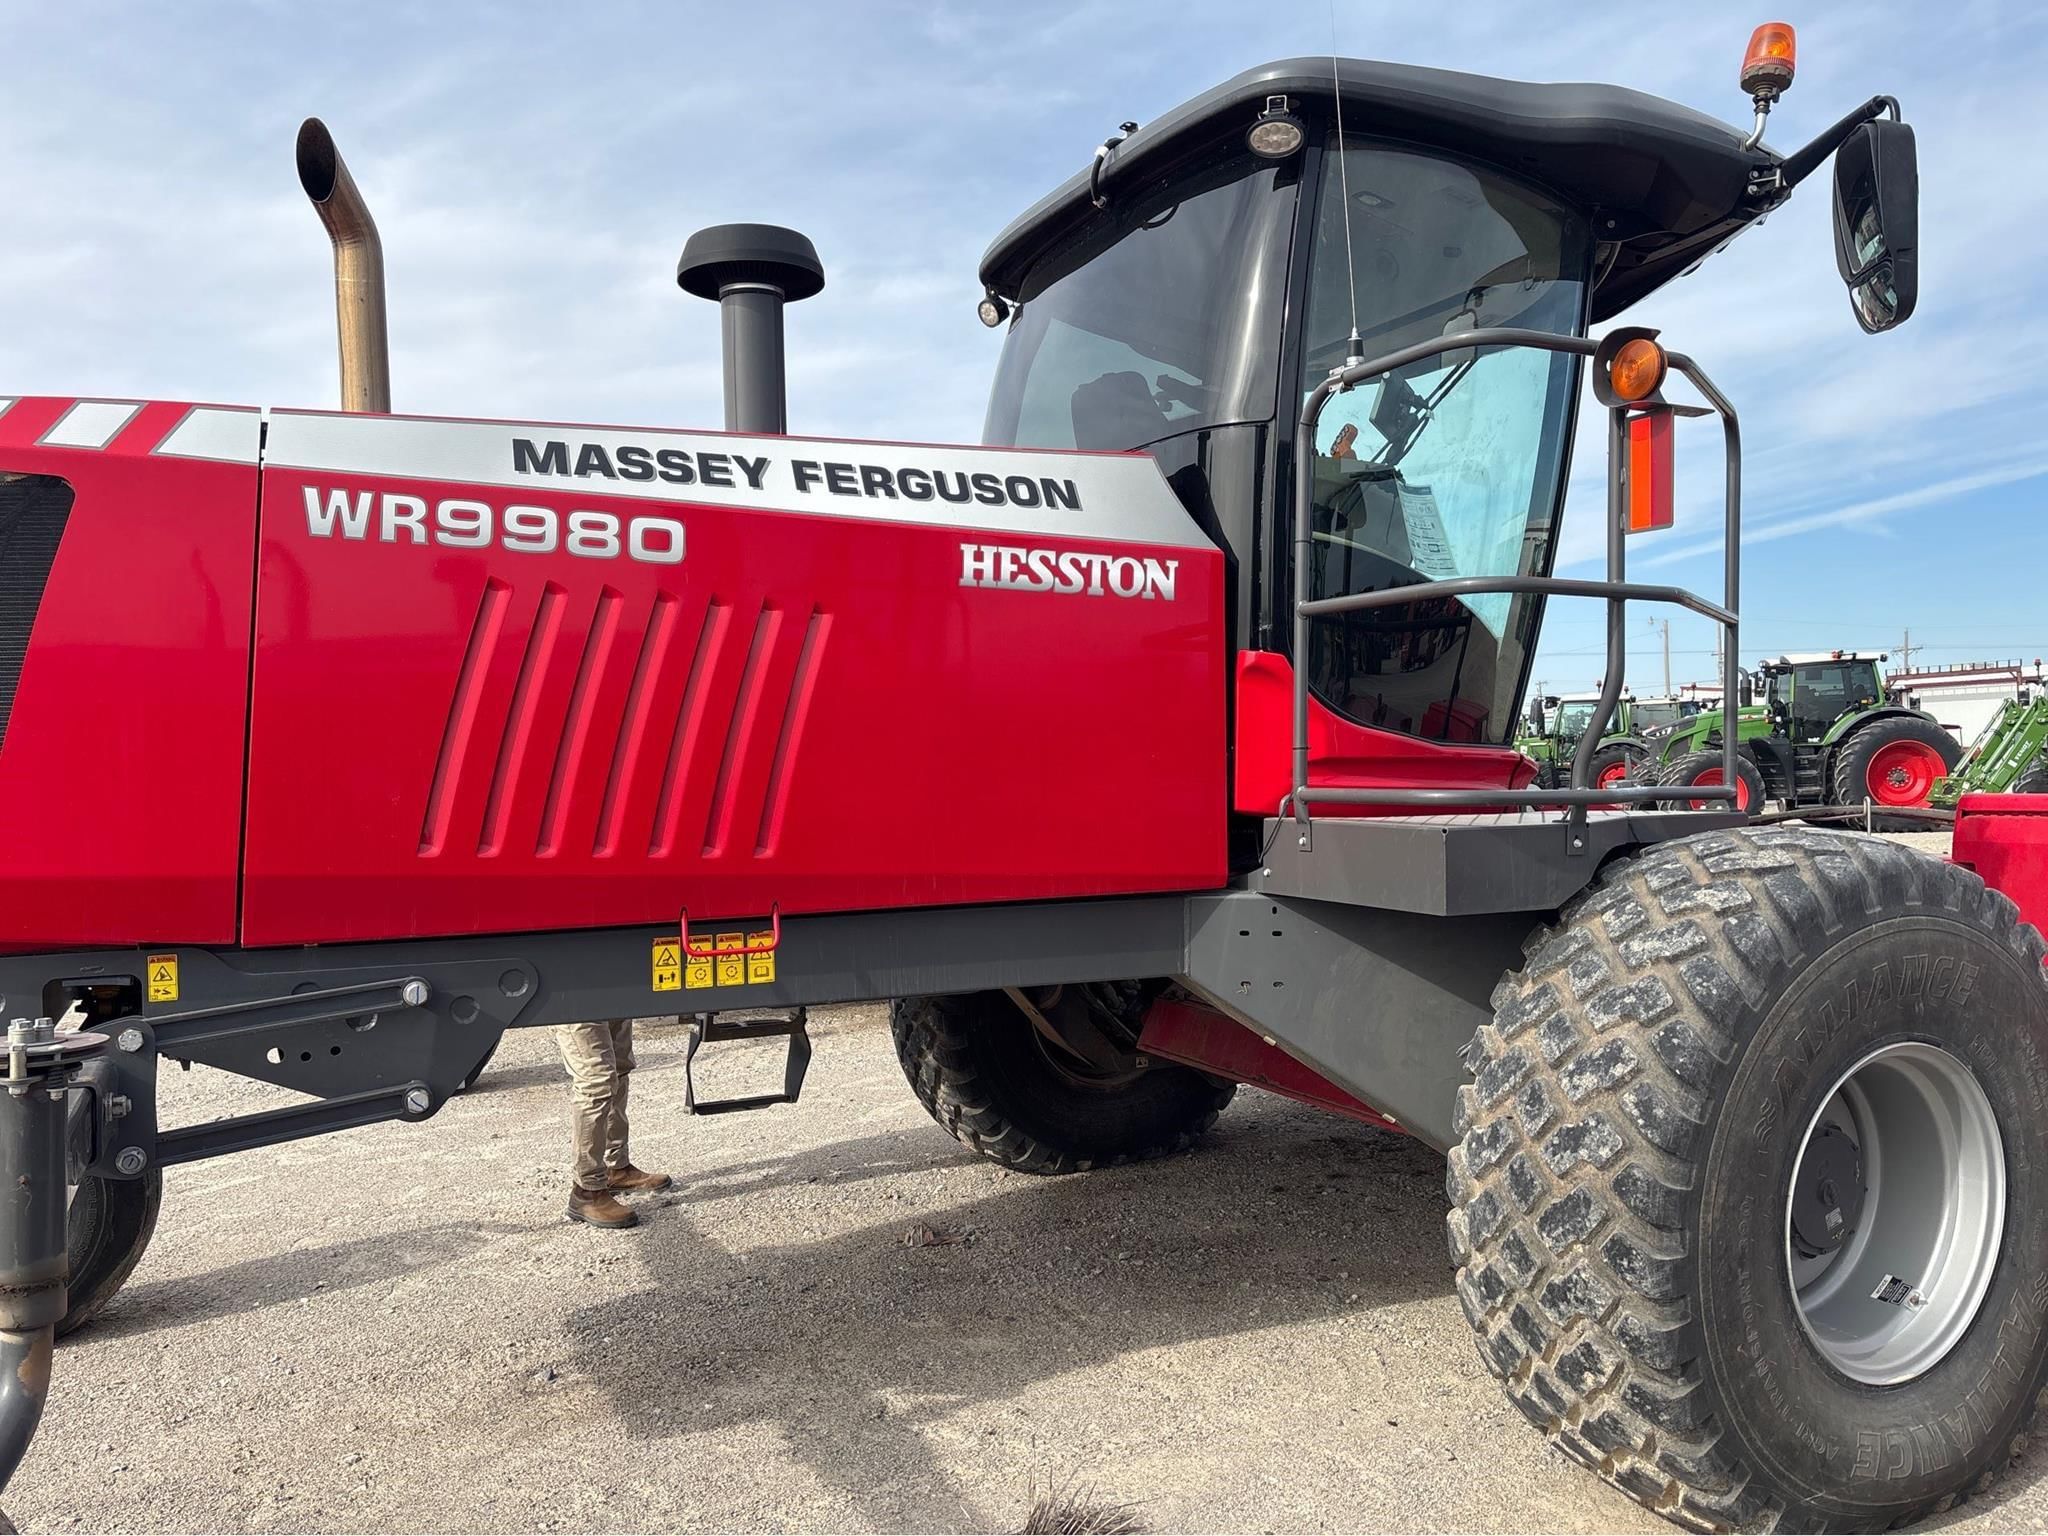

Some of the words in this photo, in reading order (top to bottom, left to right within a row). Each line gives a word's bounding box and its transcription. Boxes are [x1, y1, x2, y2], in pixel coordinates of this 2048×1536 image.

[512, 437, 771, 490] MASSEY
[791, 459, 1083, 511] FERGUSON
[301, 485, 686, 565] WR9980
[959, 543, 1179, 601] HESSTON
[1771, 953, 1981, 1115] ALLIANCE
[1851, 1287, 2041, 1481] ALLIANCE
